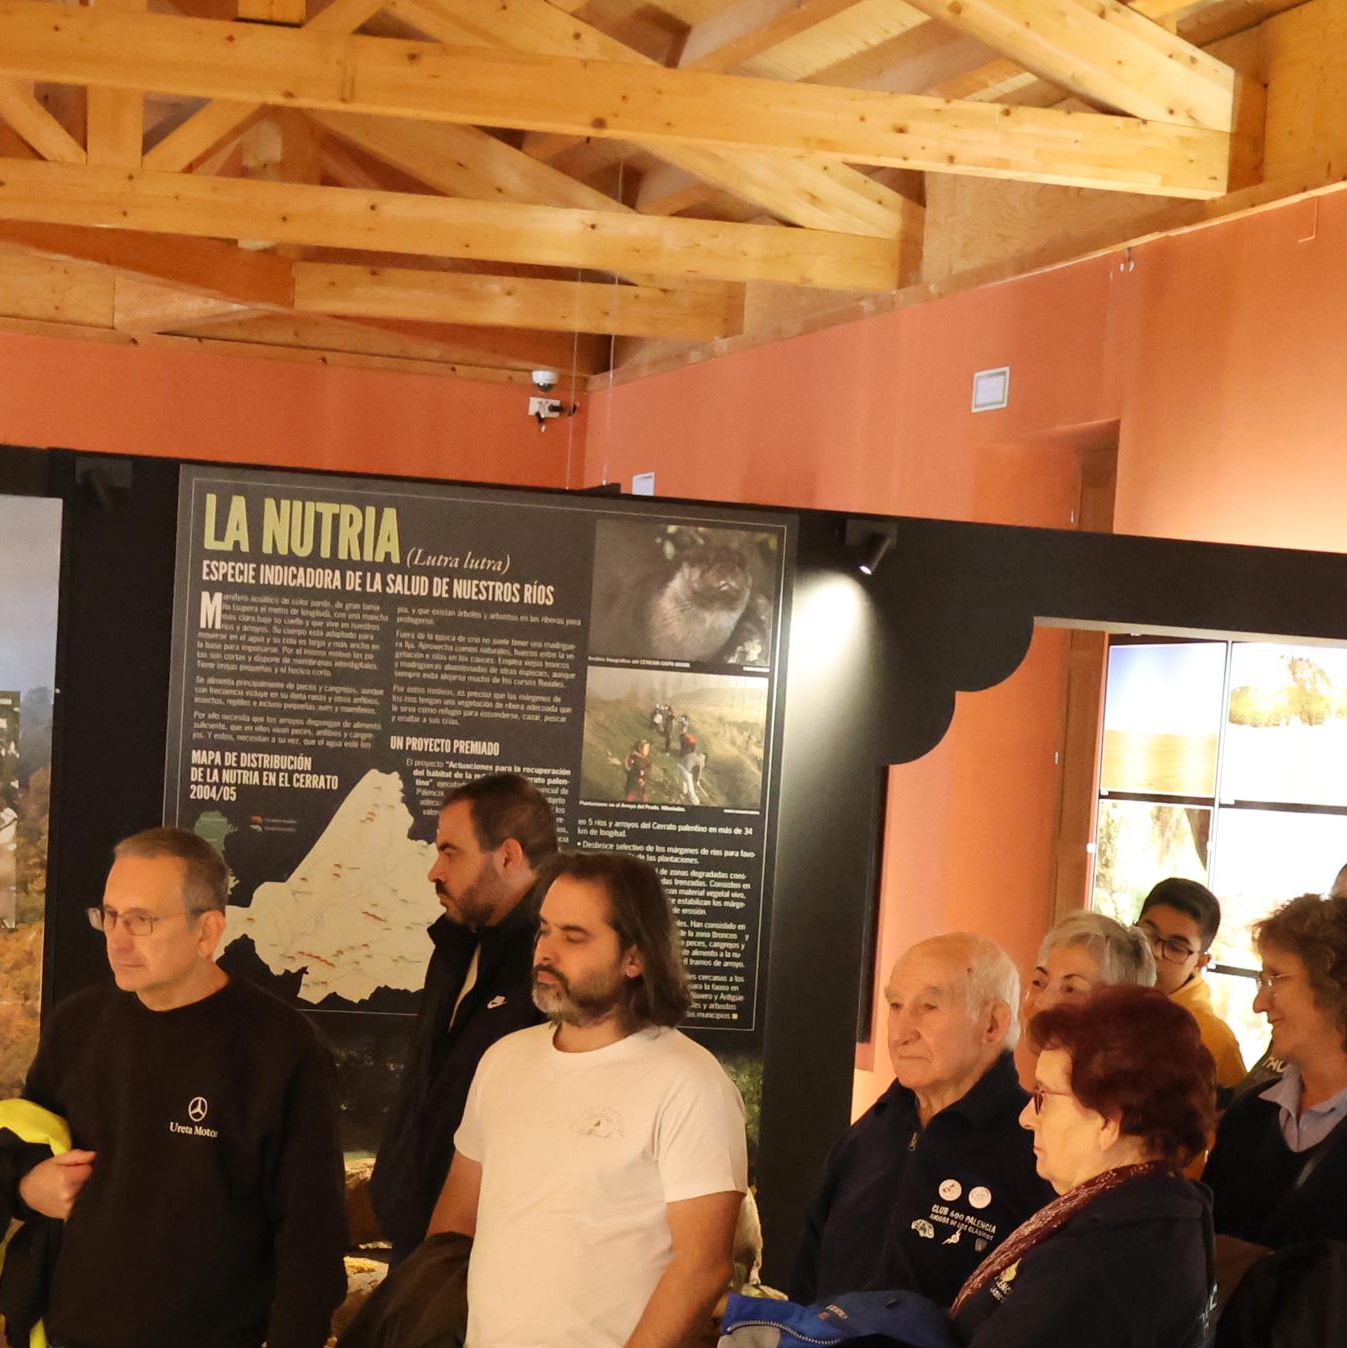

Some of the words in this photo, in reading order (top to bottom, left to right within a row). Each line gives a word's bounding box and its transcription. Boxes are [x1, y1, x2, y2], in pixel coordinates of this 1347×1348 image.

[204, 493, 250, 552] LA
[262, 498, 401, 563] NUTRIA
[406, 546, 459, 569] (Lutra
[464, 549, 510, 575] lutra)
[202, 560, 256, 585] ESPECIE
[260, 564, 342, 589] INDICADORA
[346, 571, 362, 590] DE
[366, 573, 382, 593] LA
[386, 574, 428, 597] SALUD
[432, 577, 449, 598] DE
[453, 580, 520, 602] NUESTROS
[524, 580, 554, 605] RÍOS
[390, 736, 403, 750] UN
[405, 737, 451, 753] PROYECTO
[453, 740, 499, 756] PREMIADO
[191, 750, 221, 765] MAPA
[224, 752, 238, 766] DE
[240, 753, 312, 770] DISTRIBUCIÓN
[191, 767, 204, 782] DE
[206, 768, 219, 782] LA
[222, 769, 259, 785] NUTRIA
[263, 772, 276, 786] EN
[279, 773, 290, 787] EL
[293, 774, 338, 790] CERRATO
[523, 766, 571, 777] recuperación
[189, 785, 236, 801] 2004/05
[652, 823, 677, 831] Cerrato
[678, 824, 707, 834] palentino
[724, 850, 739, 858] para
[170, 1121, 193, 1135] Ureta
[194, 1125, 218, 1138] Motor
[932, 1204, 949, 1215] CLUB
[949, 1210, 964, 1220] 600
[964, 1215, 996, 1234] PALENCIA
